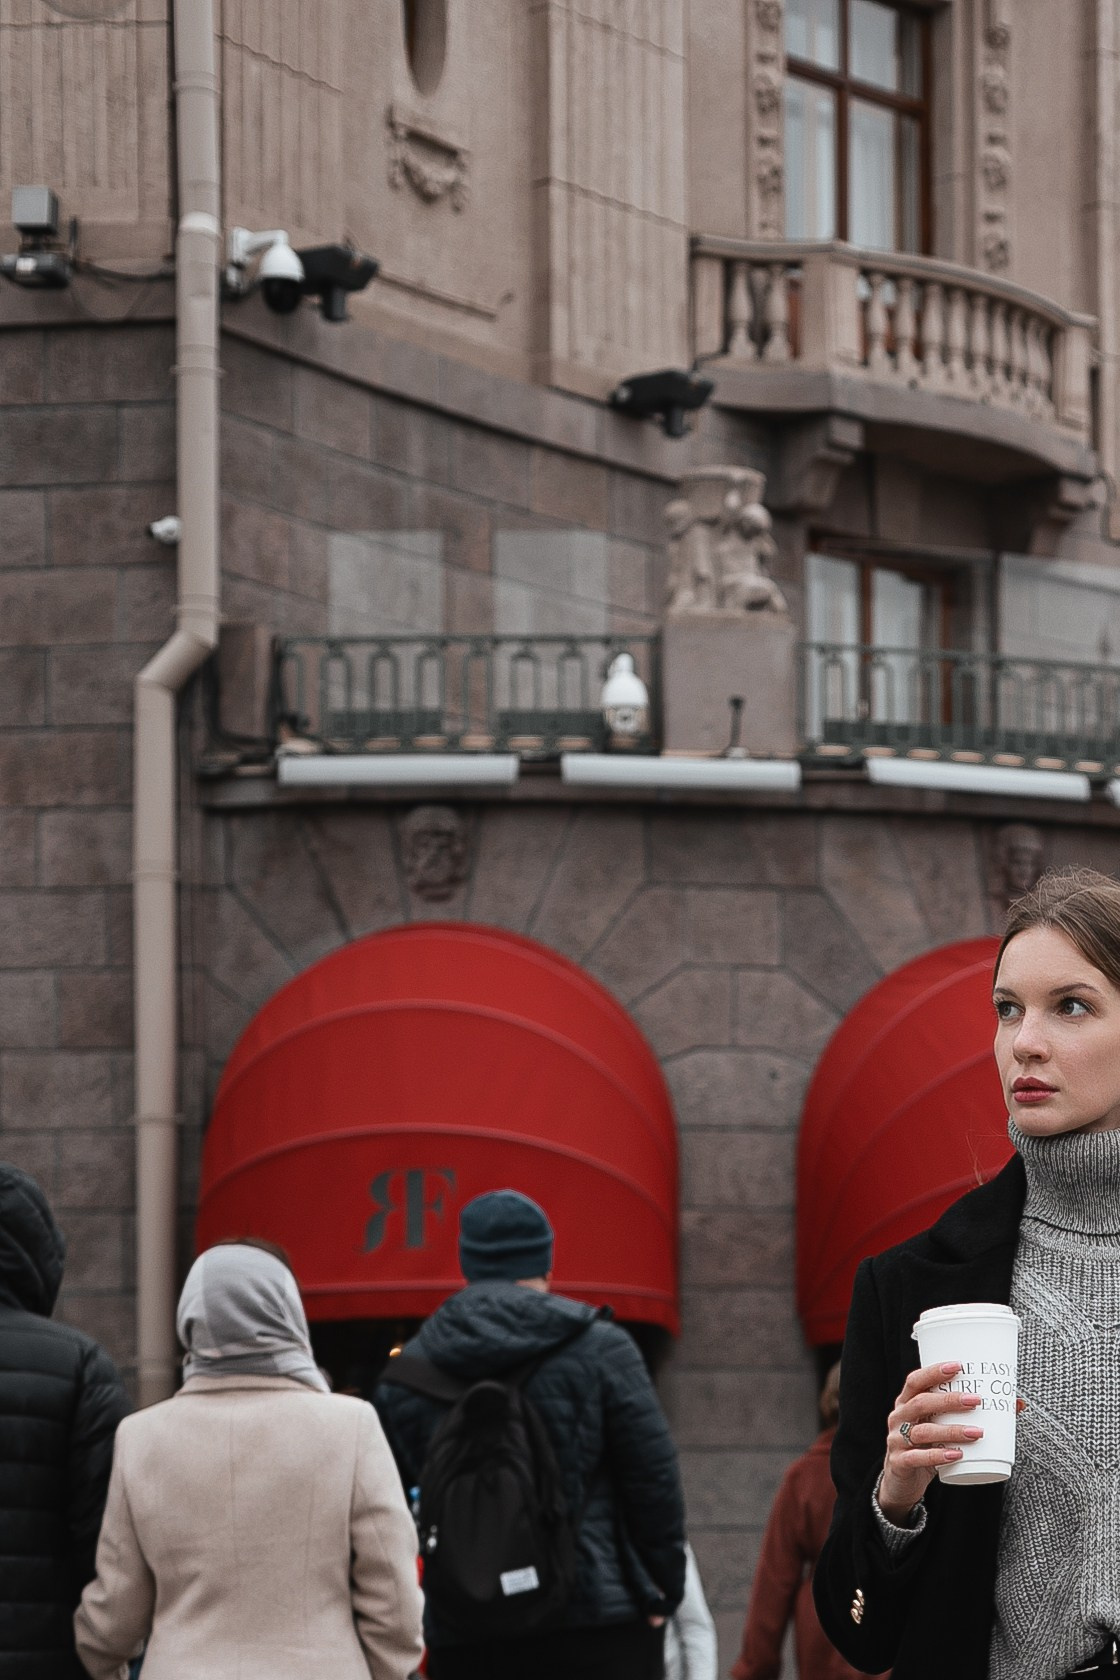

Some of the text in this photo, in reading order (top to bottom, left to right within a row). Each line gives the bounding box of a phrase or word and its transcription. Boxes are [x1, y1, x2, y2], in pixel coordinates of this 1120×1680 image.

[981, 1362, 1012, 1376] EASY
[938, 1379, 984, 1394] SURF
[982, 1398, 1011, 1412] EASY
